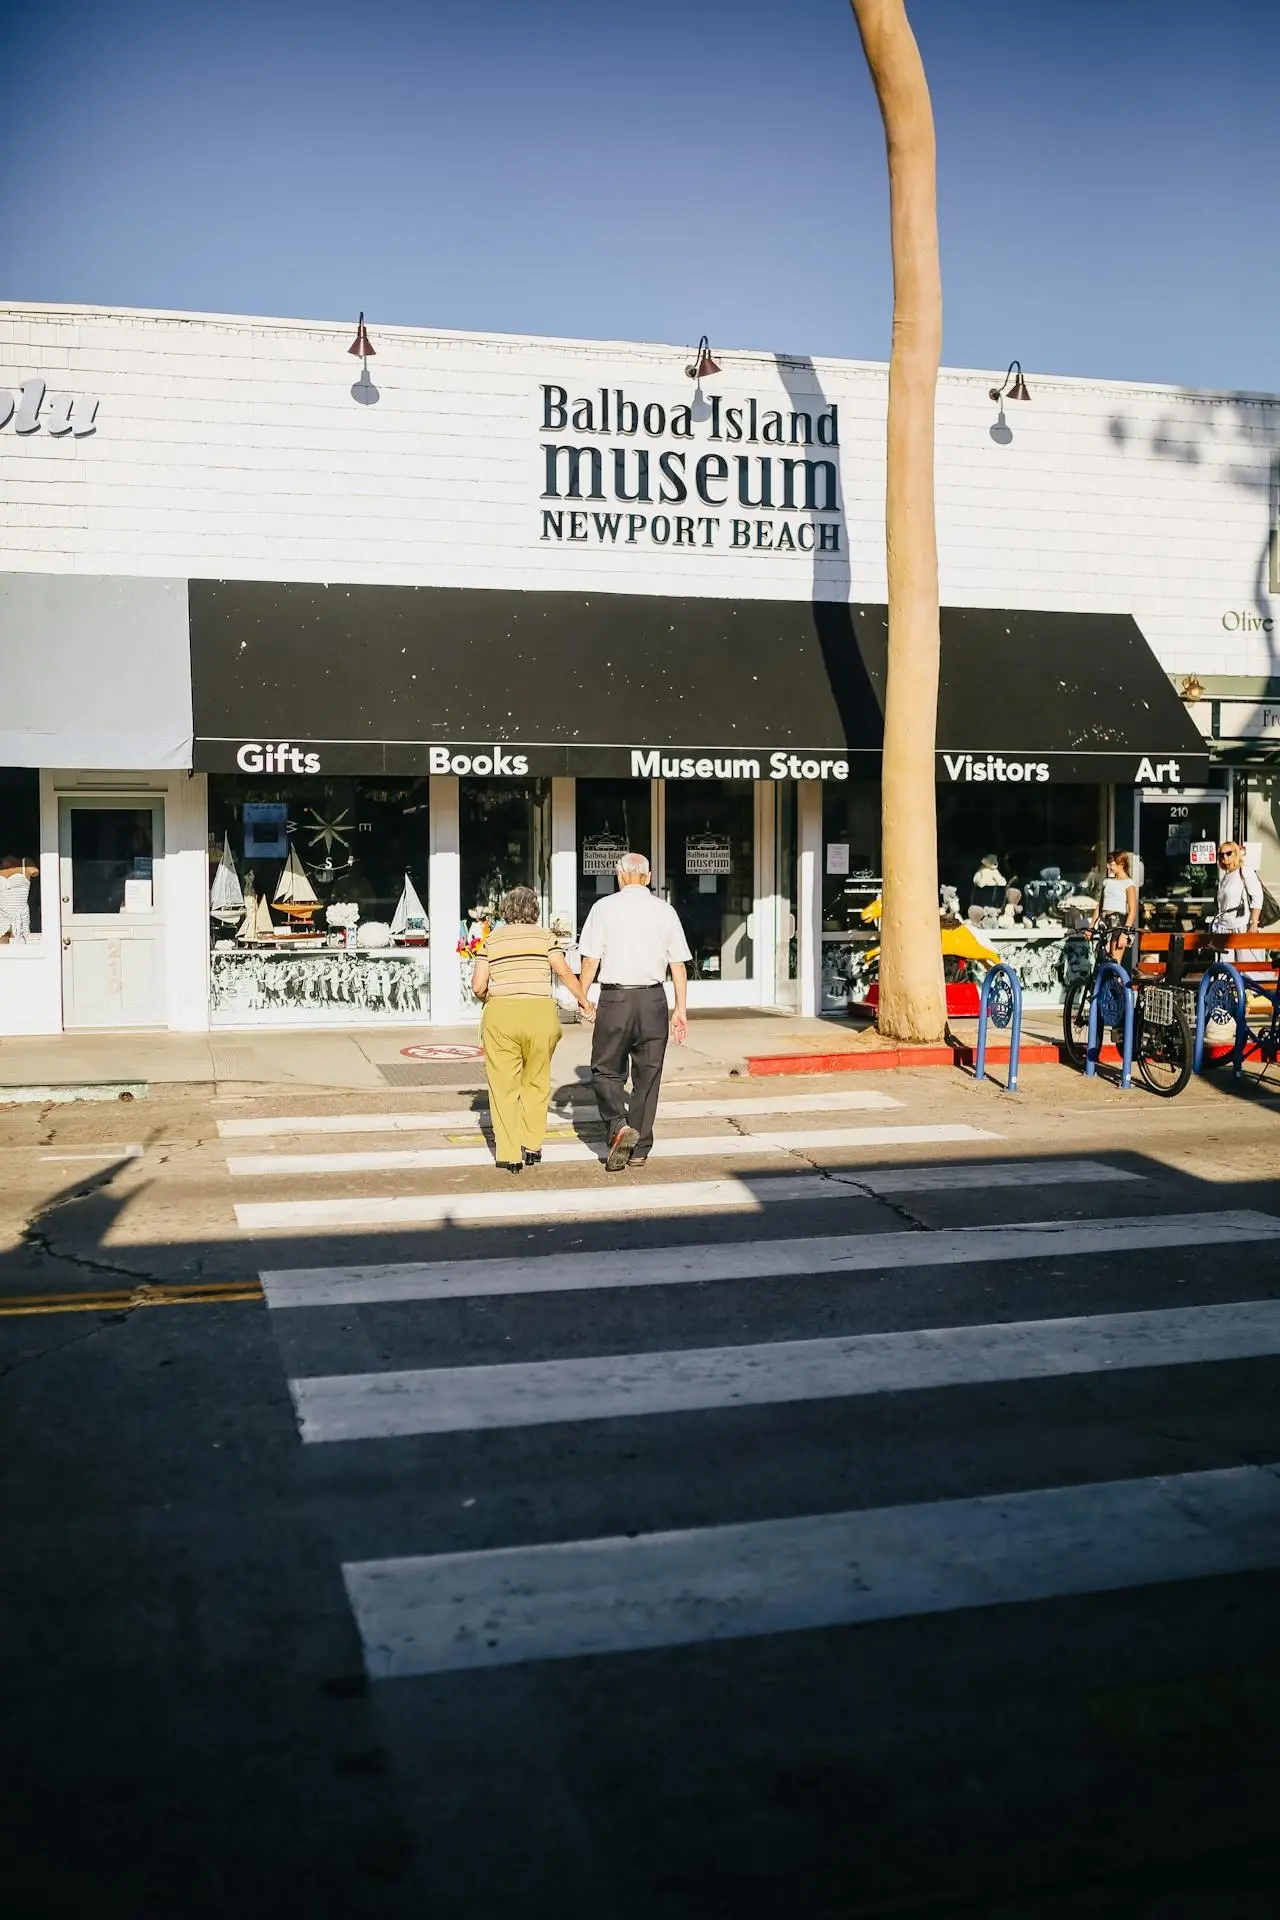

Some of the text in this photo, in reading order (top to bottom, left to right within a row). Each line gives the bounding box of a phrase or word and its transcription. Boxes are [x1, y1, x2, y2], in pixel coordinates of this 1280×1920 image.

[539, 384, 841, 448] Balboa Island
[539, 443, 841, 512] museum
[539, 509, 841, 551] NEWPORT BEACH
[1222, 611, 1274, 632] Olive
[1263, 709, 1280, 727] Fr
[236, 743, 321, 774] Gifts
[429, 746, 529, 776] Books
[631, 750, 850, 780] Museum Store
[943, 754, 1050, 782] Visitors
[1134, 757, 1181, 783] Art
[1170, 806, 1188, 818] 210
[687, 859, 729, 868] museum
